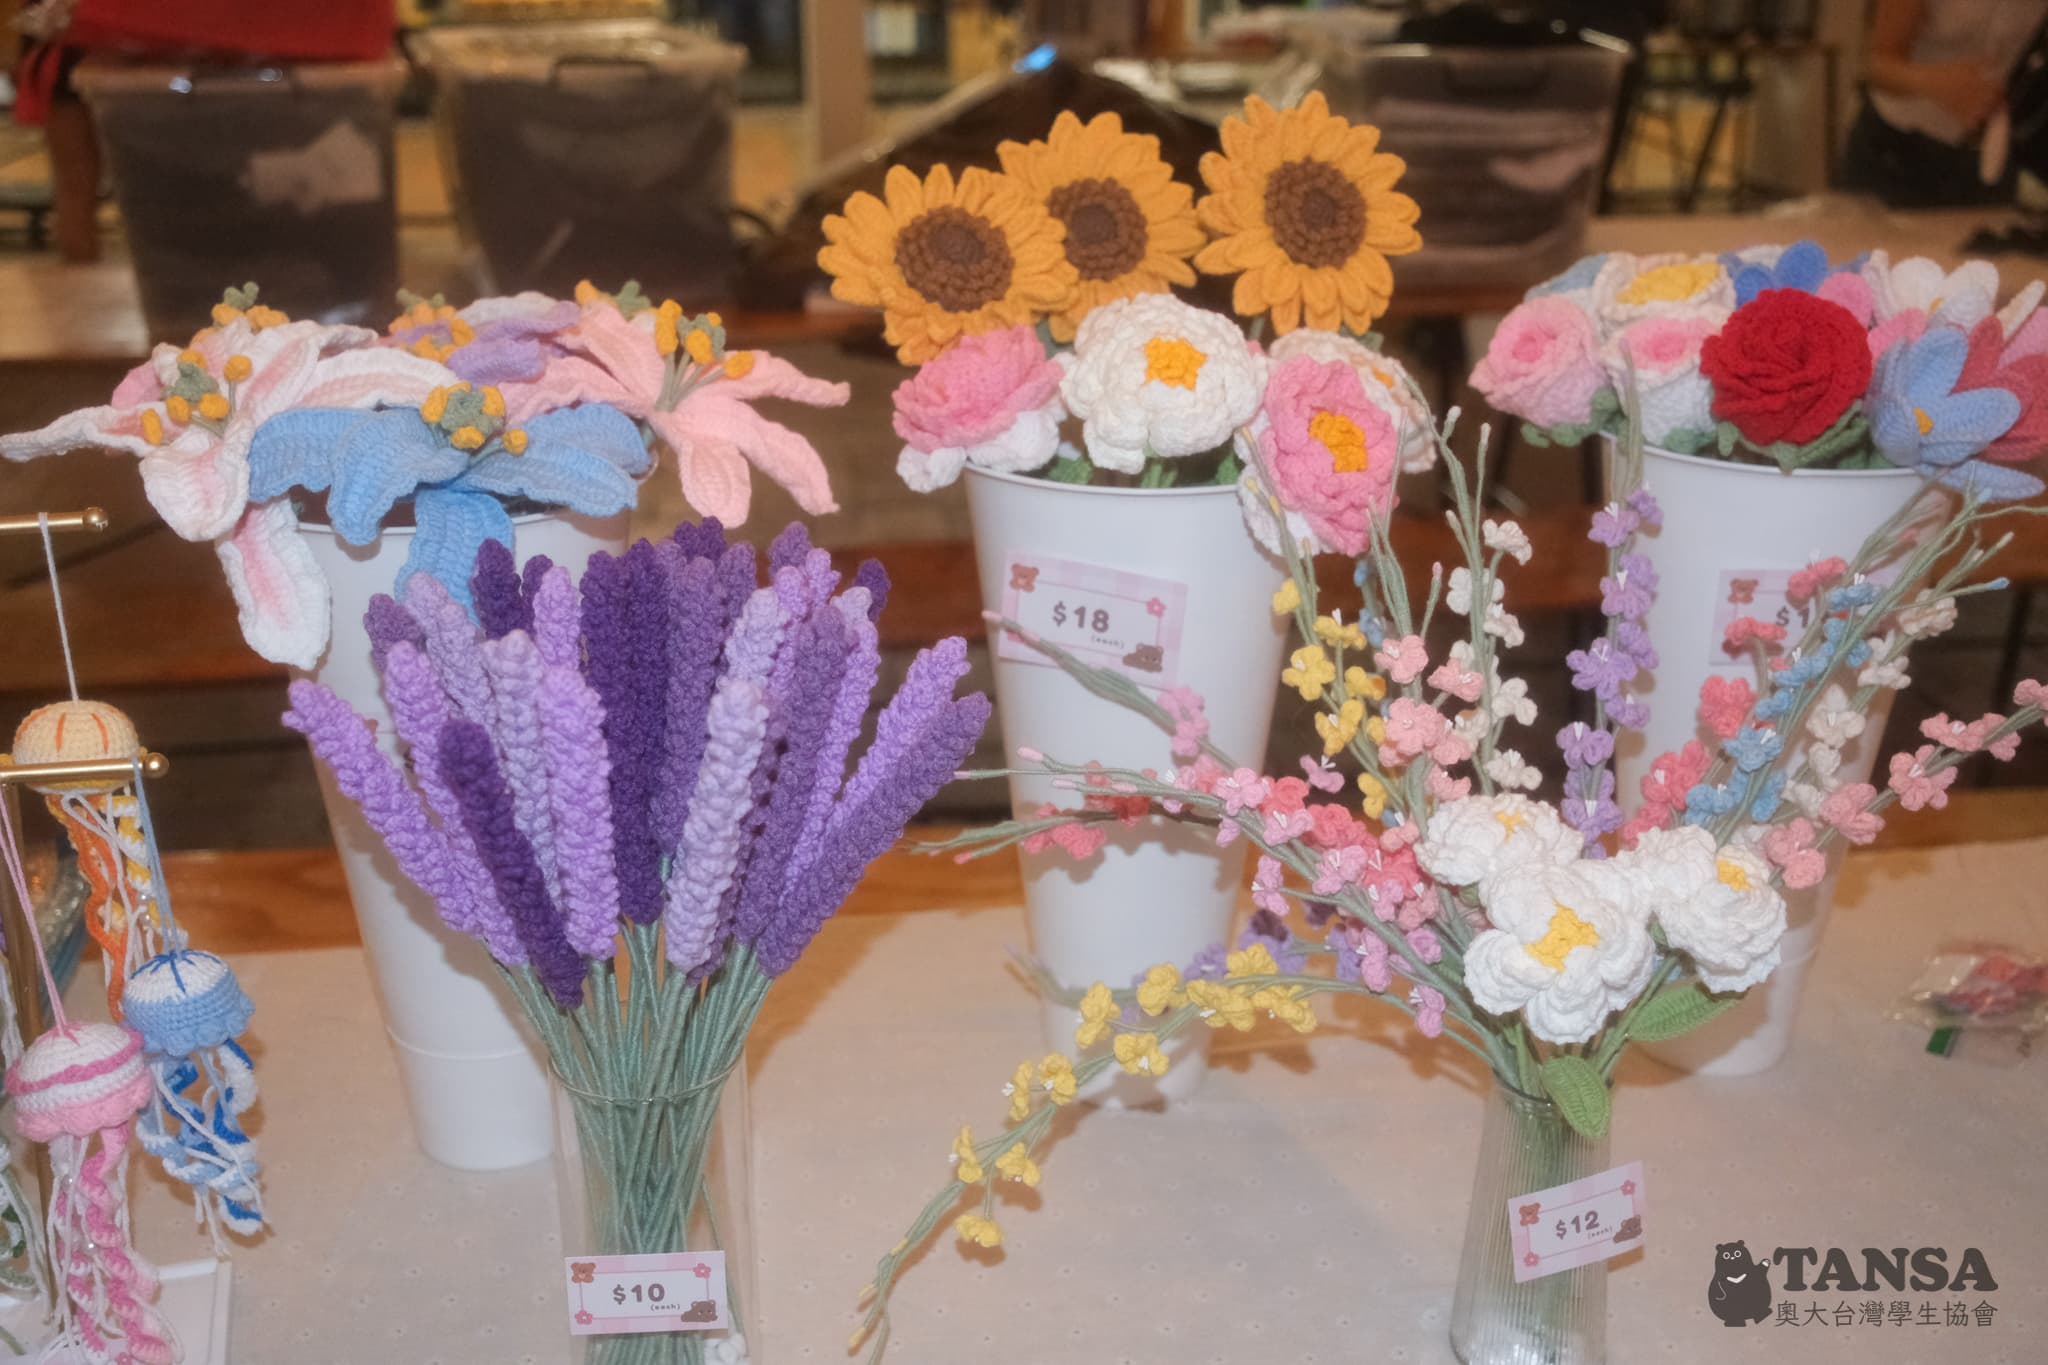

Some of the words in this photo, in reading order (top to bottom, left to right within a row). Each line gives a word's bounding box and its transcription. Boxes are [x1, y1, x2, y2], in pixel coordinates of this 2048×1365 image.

[1053, 601, 1109, 633] $18
[1775, 606, 1810, 628] $1
[1555, 1210, 1600, 1240] $12
[612, 1283, 665, 1305] $10
